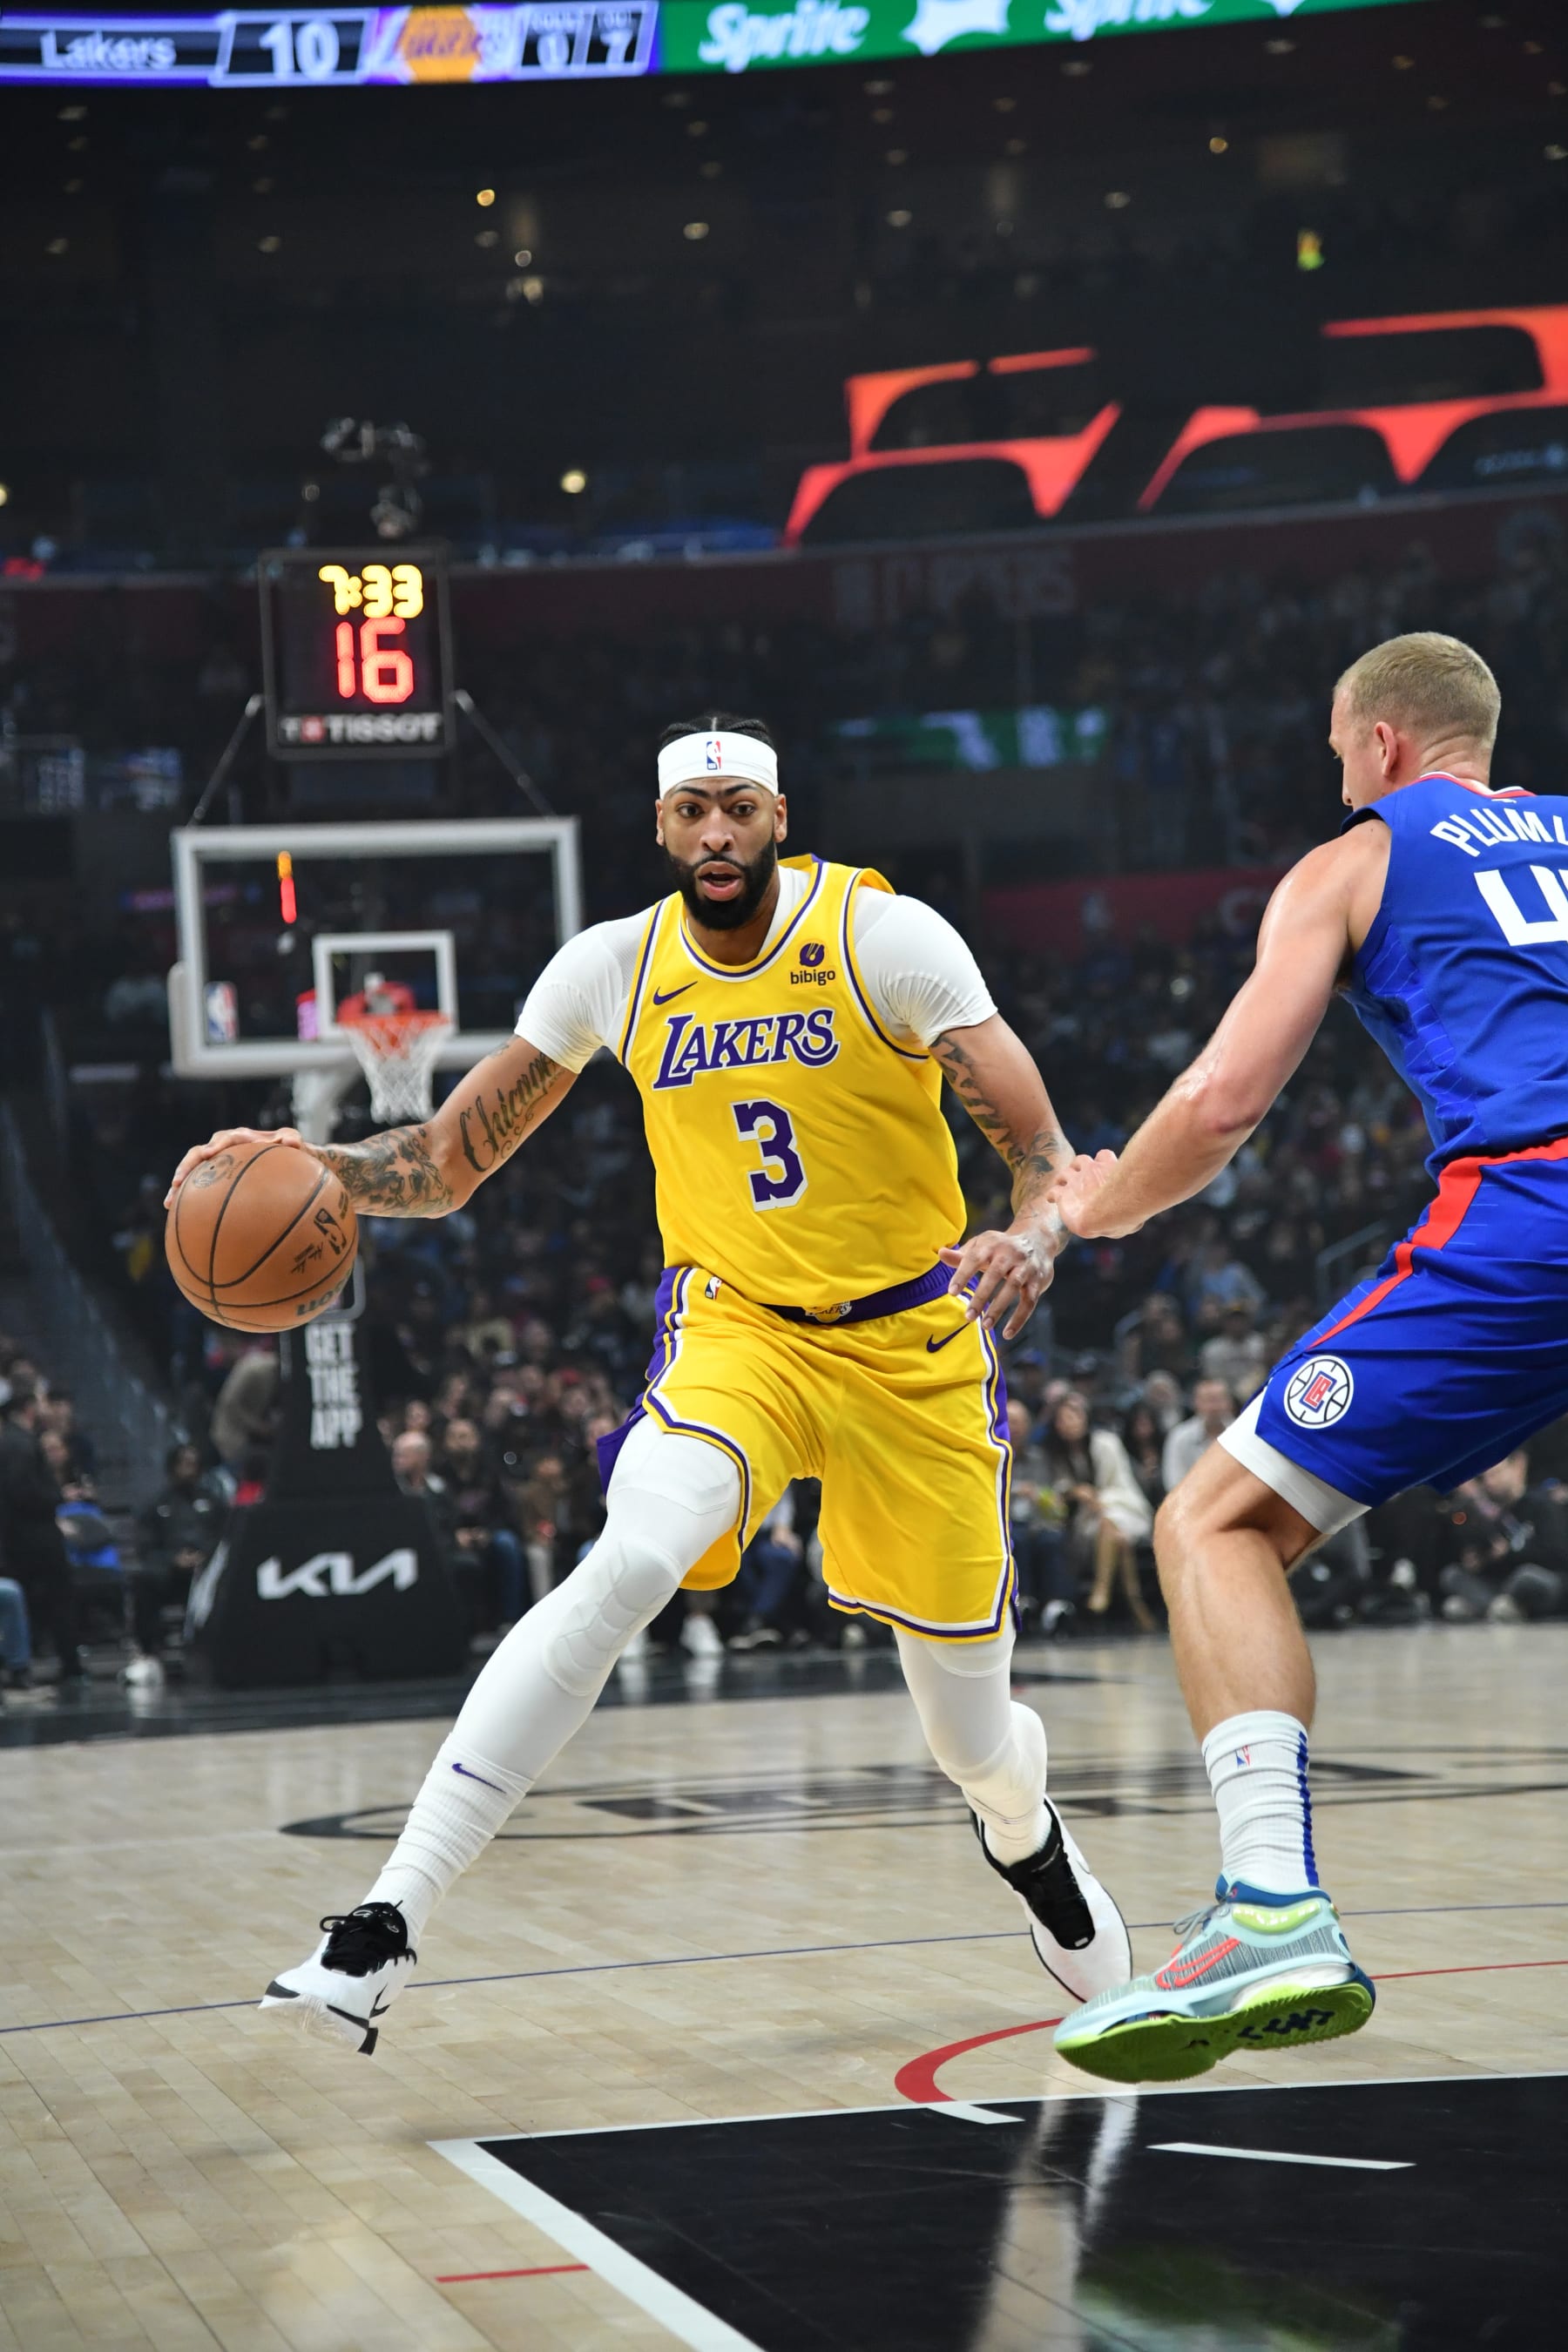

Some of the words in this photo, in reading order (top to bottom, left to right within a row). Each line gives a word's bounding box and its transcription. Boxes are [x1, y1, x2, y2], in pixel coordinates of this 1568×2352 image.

[40, 29, 178, 71] Lakers
[259, 19, 341, 82] 10
[699, 1, 871, 72] Sprite
[318, 564, 424, 619] 7:33
[335, 616, 415, 704] 16
[326, 712, 443, 743] TISSOT
[1473, 864, 1568, 947] 4
[790, 969, 836, 987] bibigo
[652, 1008, 841, 1091] LAKERS
[731, 1098, 809, 1213] 3
[305, 1322, 356, 1362] GET
[307, 1363, 362, 1405] THE
[310, 1407, 363, 1450] APP
